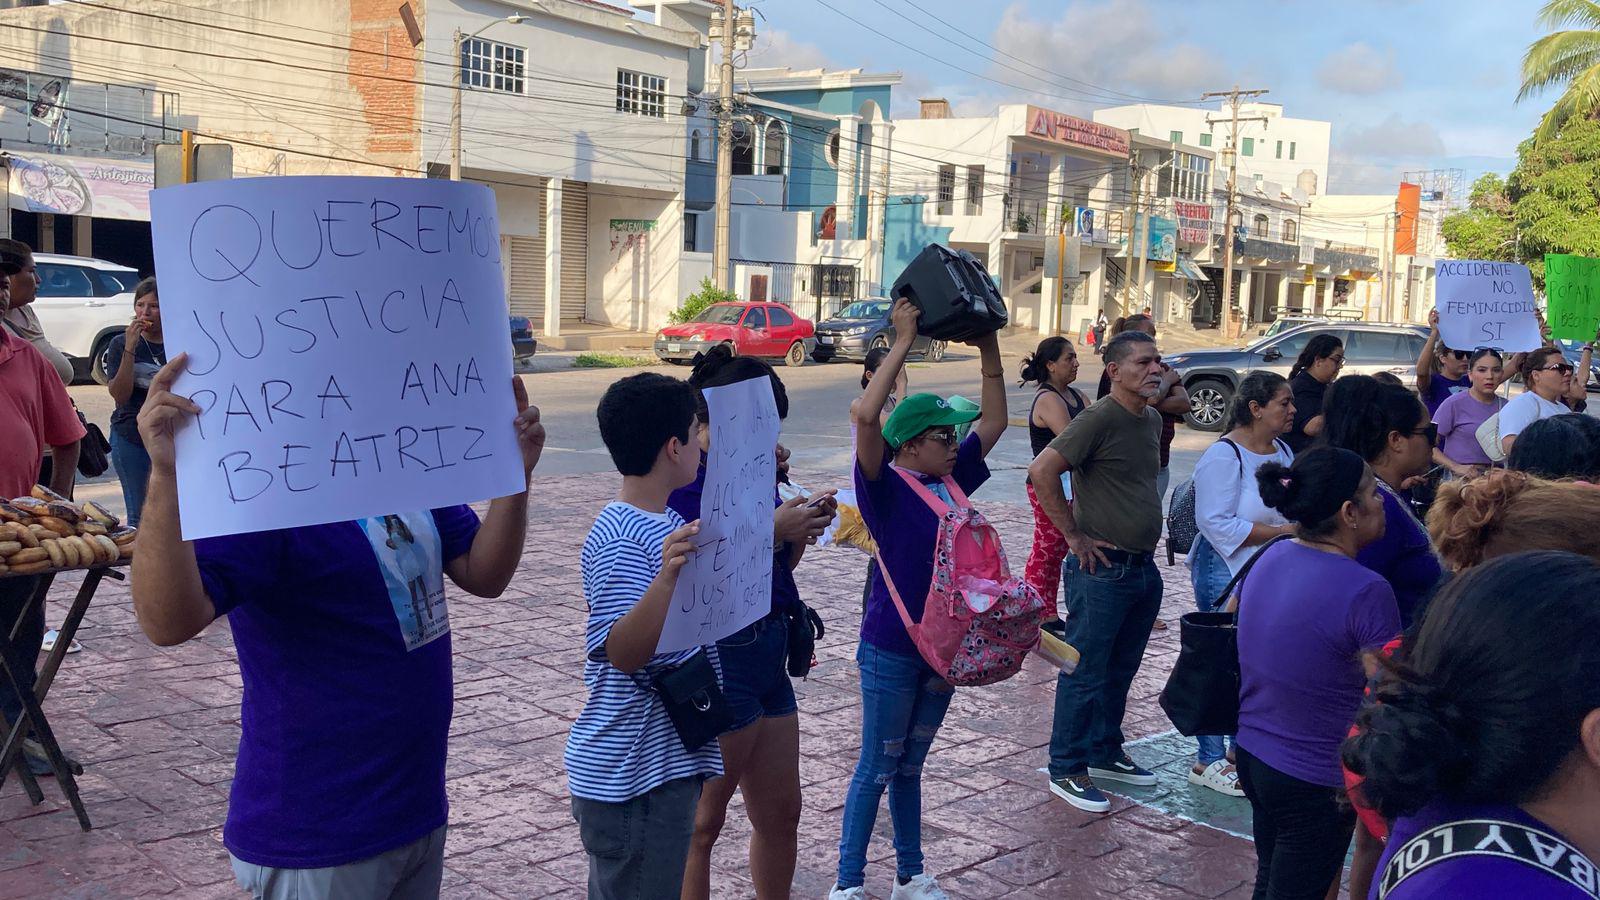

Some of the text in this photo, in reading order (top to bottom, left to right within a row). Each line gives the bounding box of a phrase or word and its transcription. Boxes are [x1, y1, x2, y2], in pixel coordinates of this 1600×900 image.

[189, 198, 500, 288] QUEREMOS
[1438, 263, 1512, 277] ACCIDENTE
[185, 278, 472, 376] JUSTICIA
[1447, 301, 1535, 315] FEMINICIDIO
[1481, 321, 1506, 342] SI
[188, 357, 486, 440] PARA ANA
[217, 426, 494, 504] BEATRIZ
